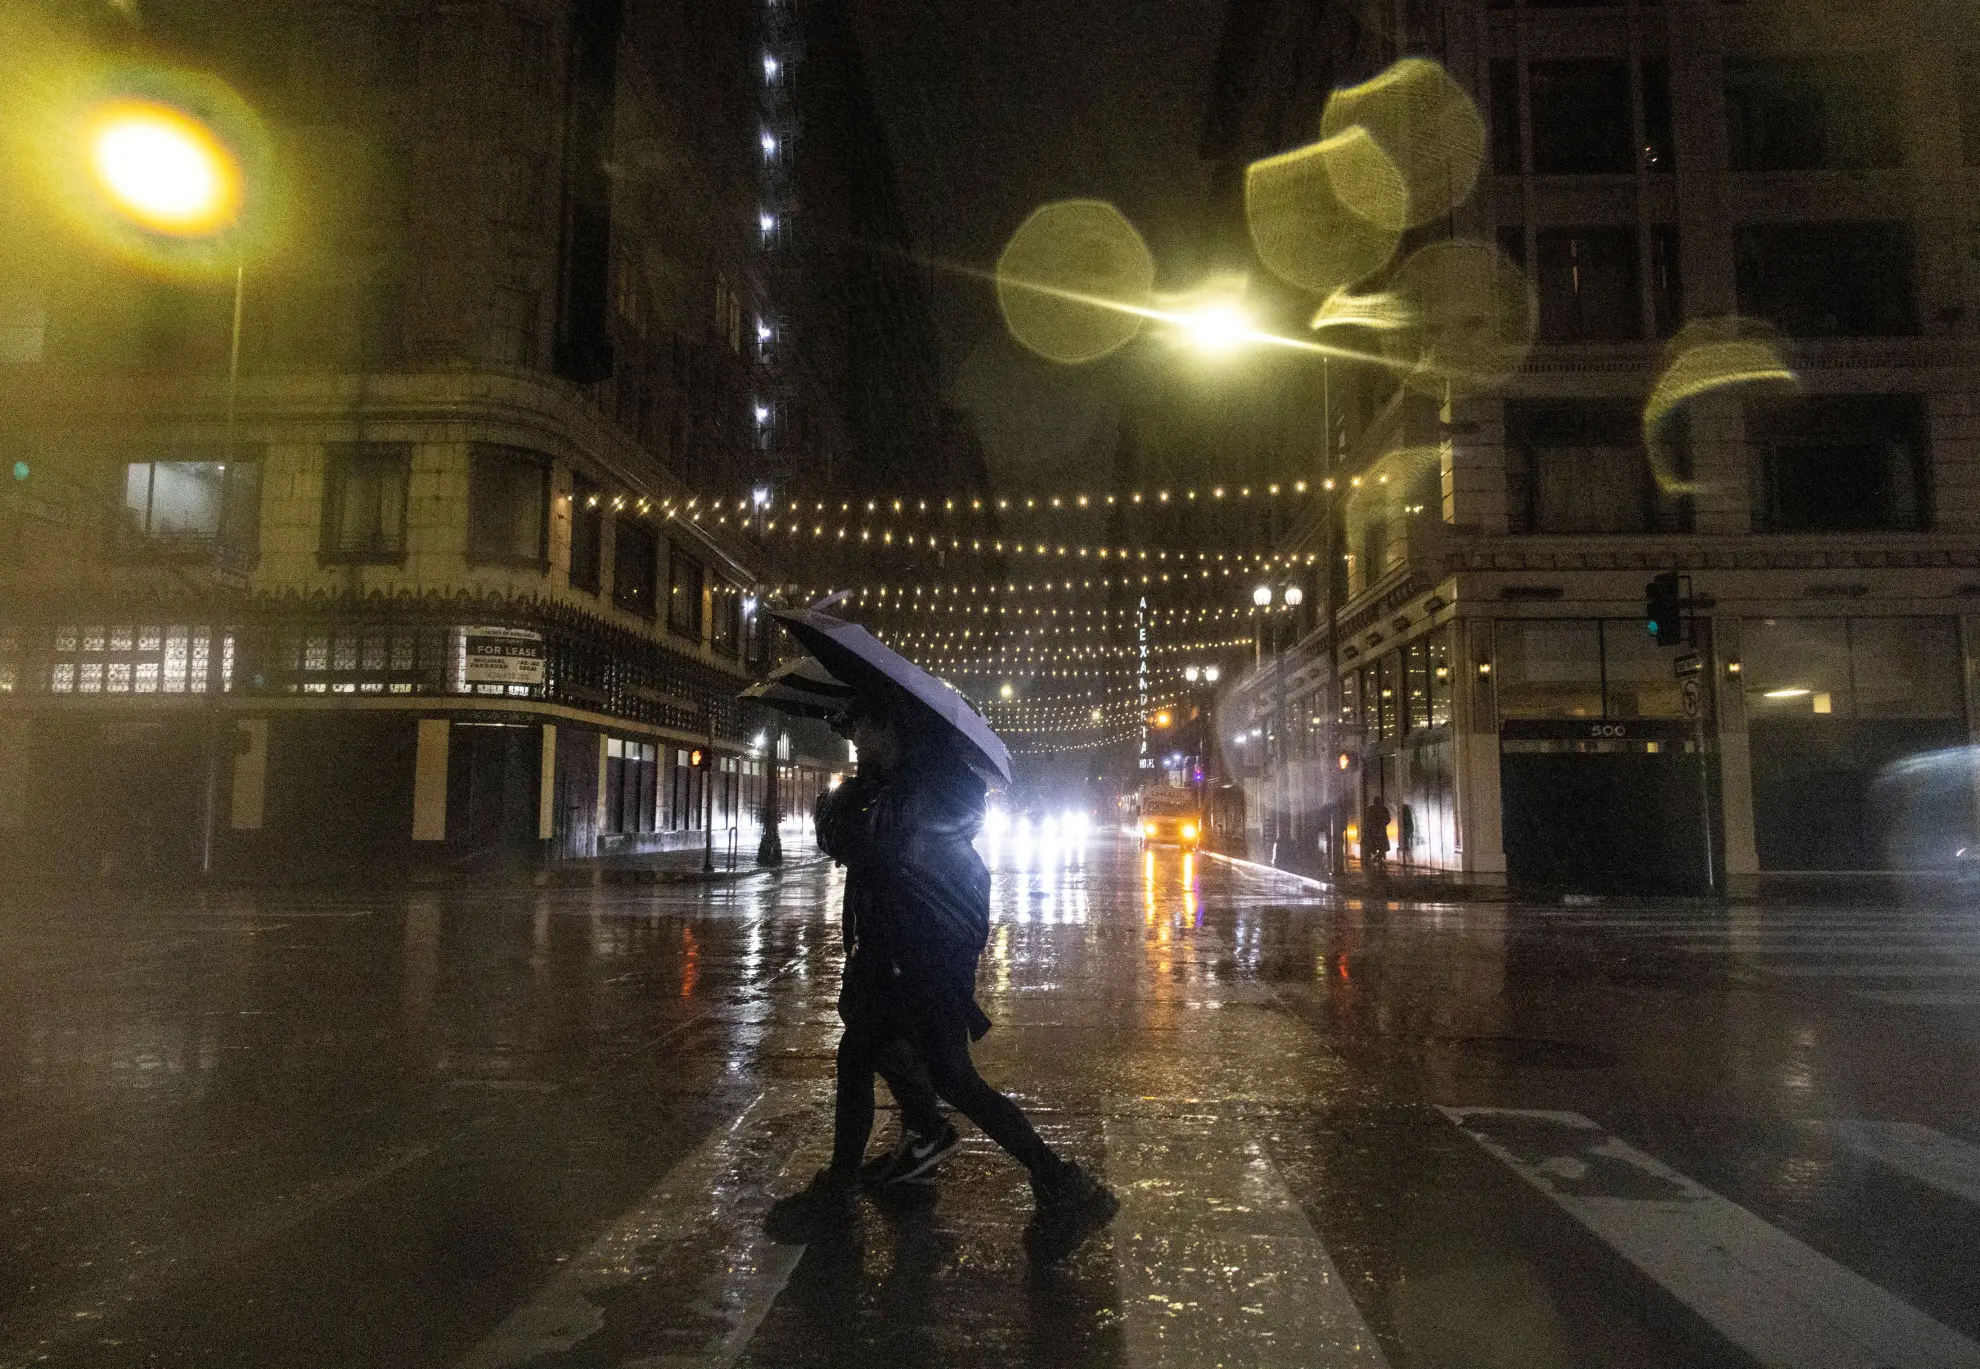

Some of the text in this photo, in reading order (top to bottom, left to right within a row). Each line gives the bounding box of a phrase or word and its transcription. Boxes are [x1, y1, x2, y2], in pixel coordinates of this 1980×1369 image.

[477, 645, 537, 657] FOR LEASE
[1592, 725, 1625, 737] 500
